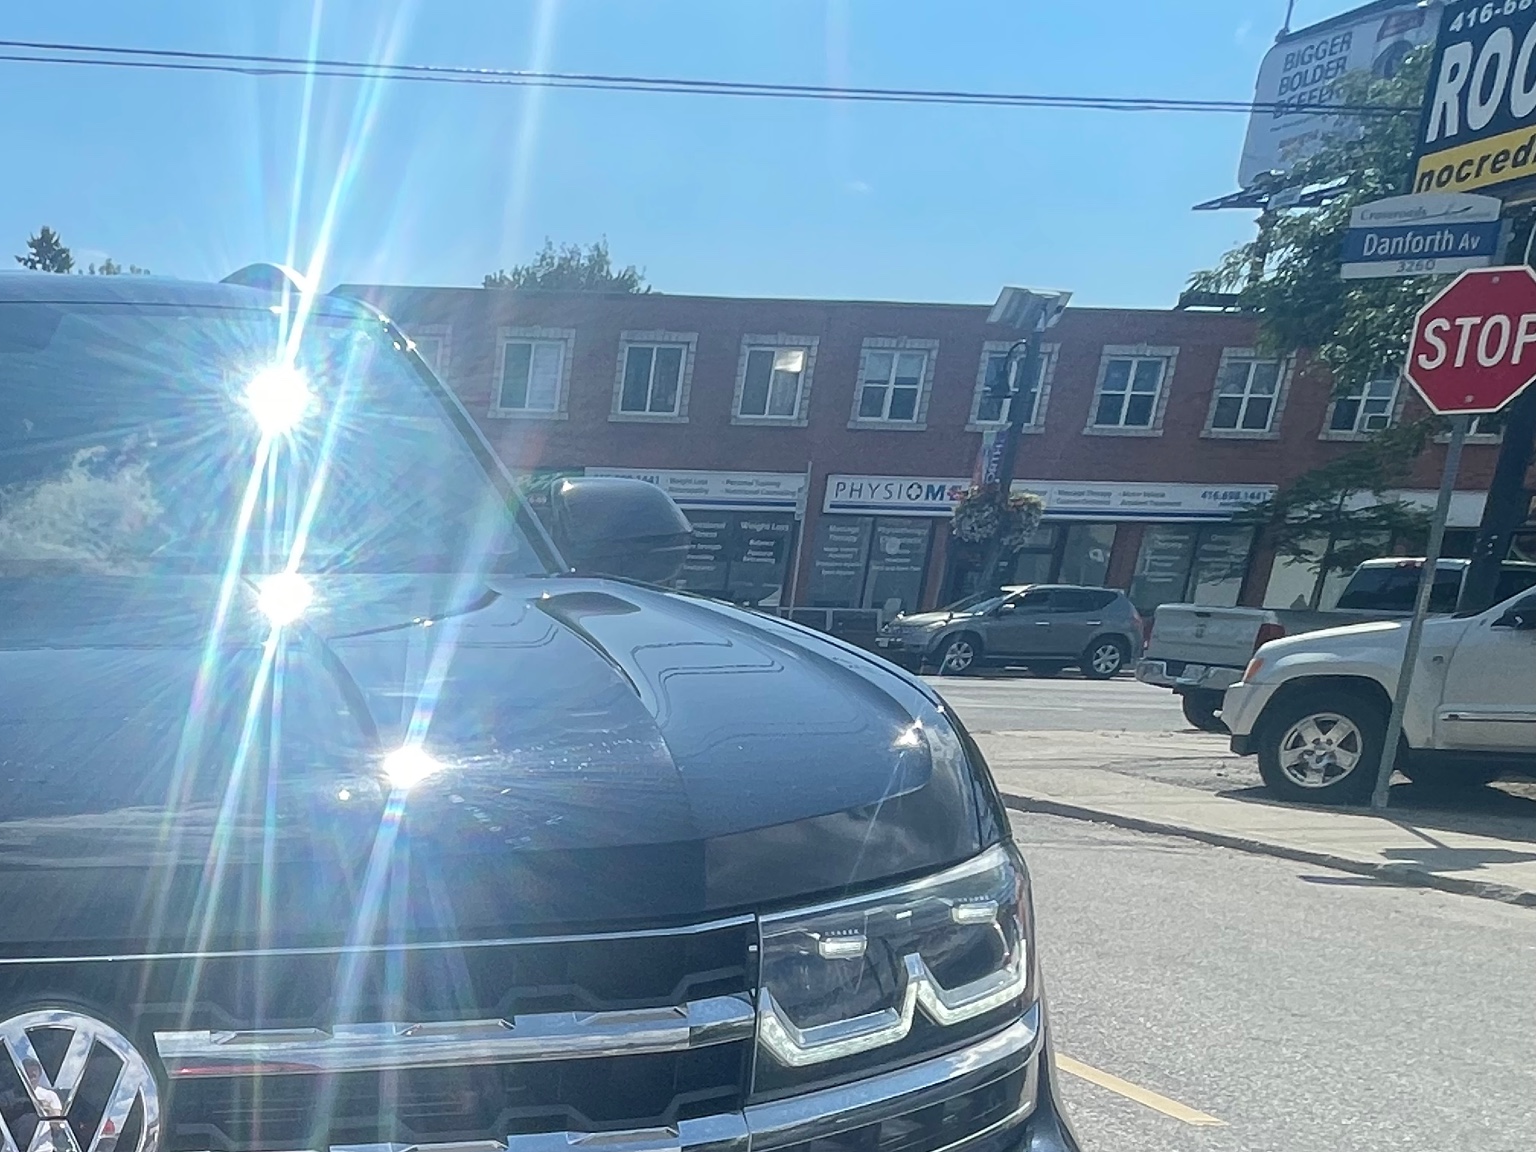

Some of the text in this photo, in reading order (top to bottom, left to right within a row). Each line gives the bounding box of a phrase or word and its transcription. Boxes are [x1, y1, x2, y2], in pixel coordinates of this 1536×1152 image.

[1283, 32, 1353, 73] BIGGER
[1278, 56, 1347, 97] BOLDER
[1363, 229, 1481, 256] Danforth Av
[1396, 259, 1436, 273] 3260
[1418, 313, 1536, 370] STOP
